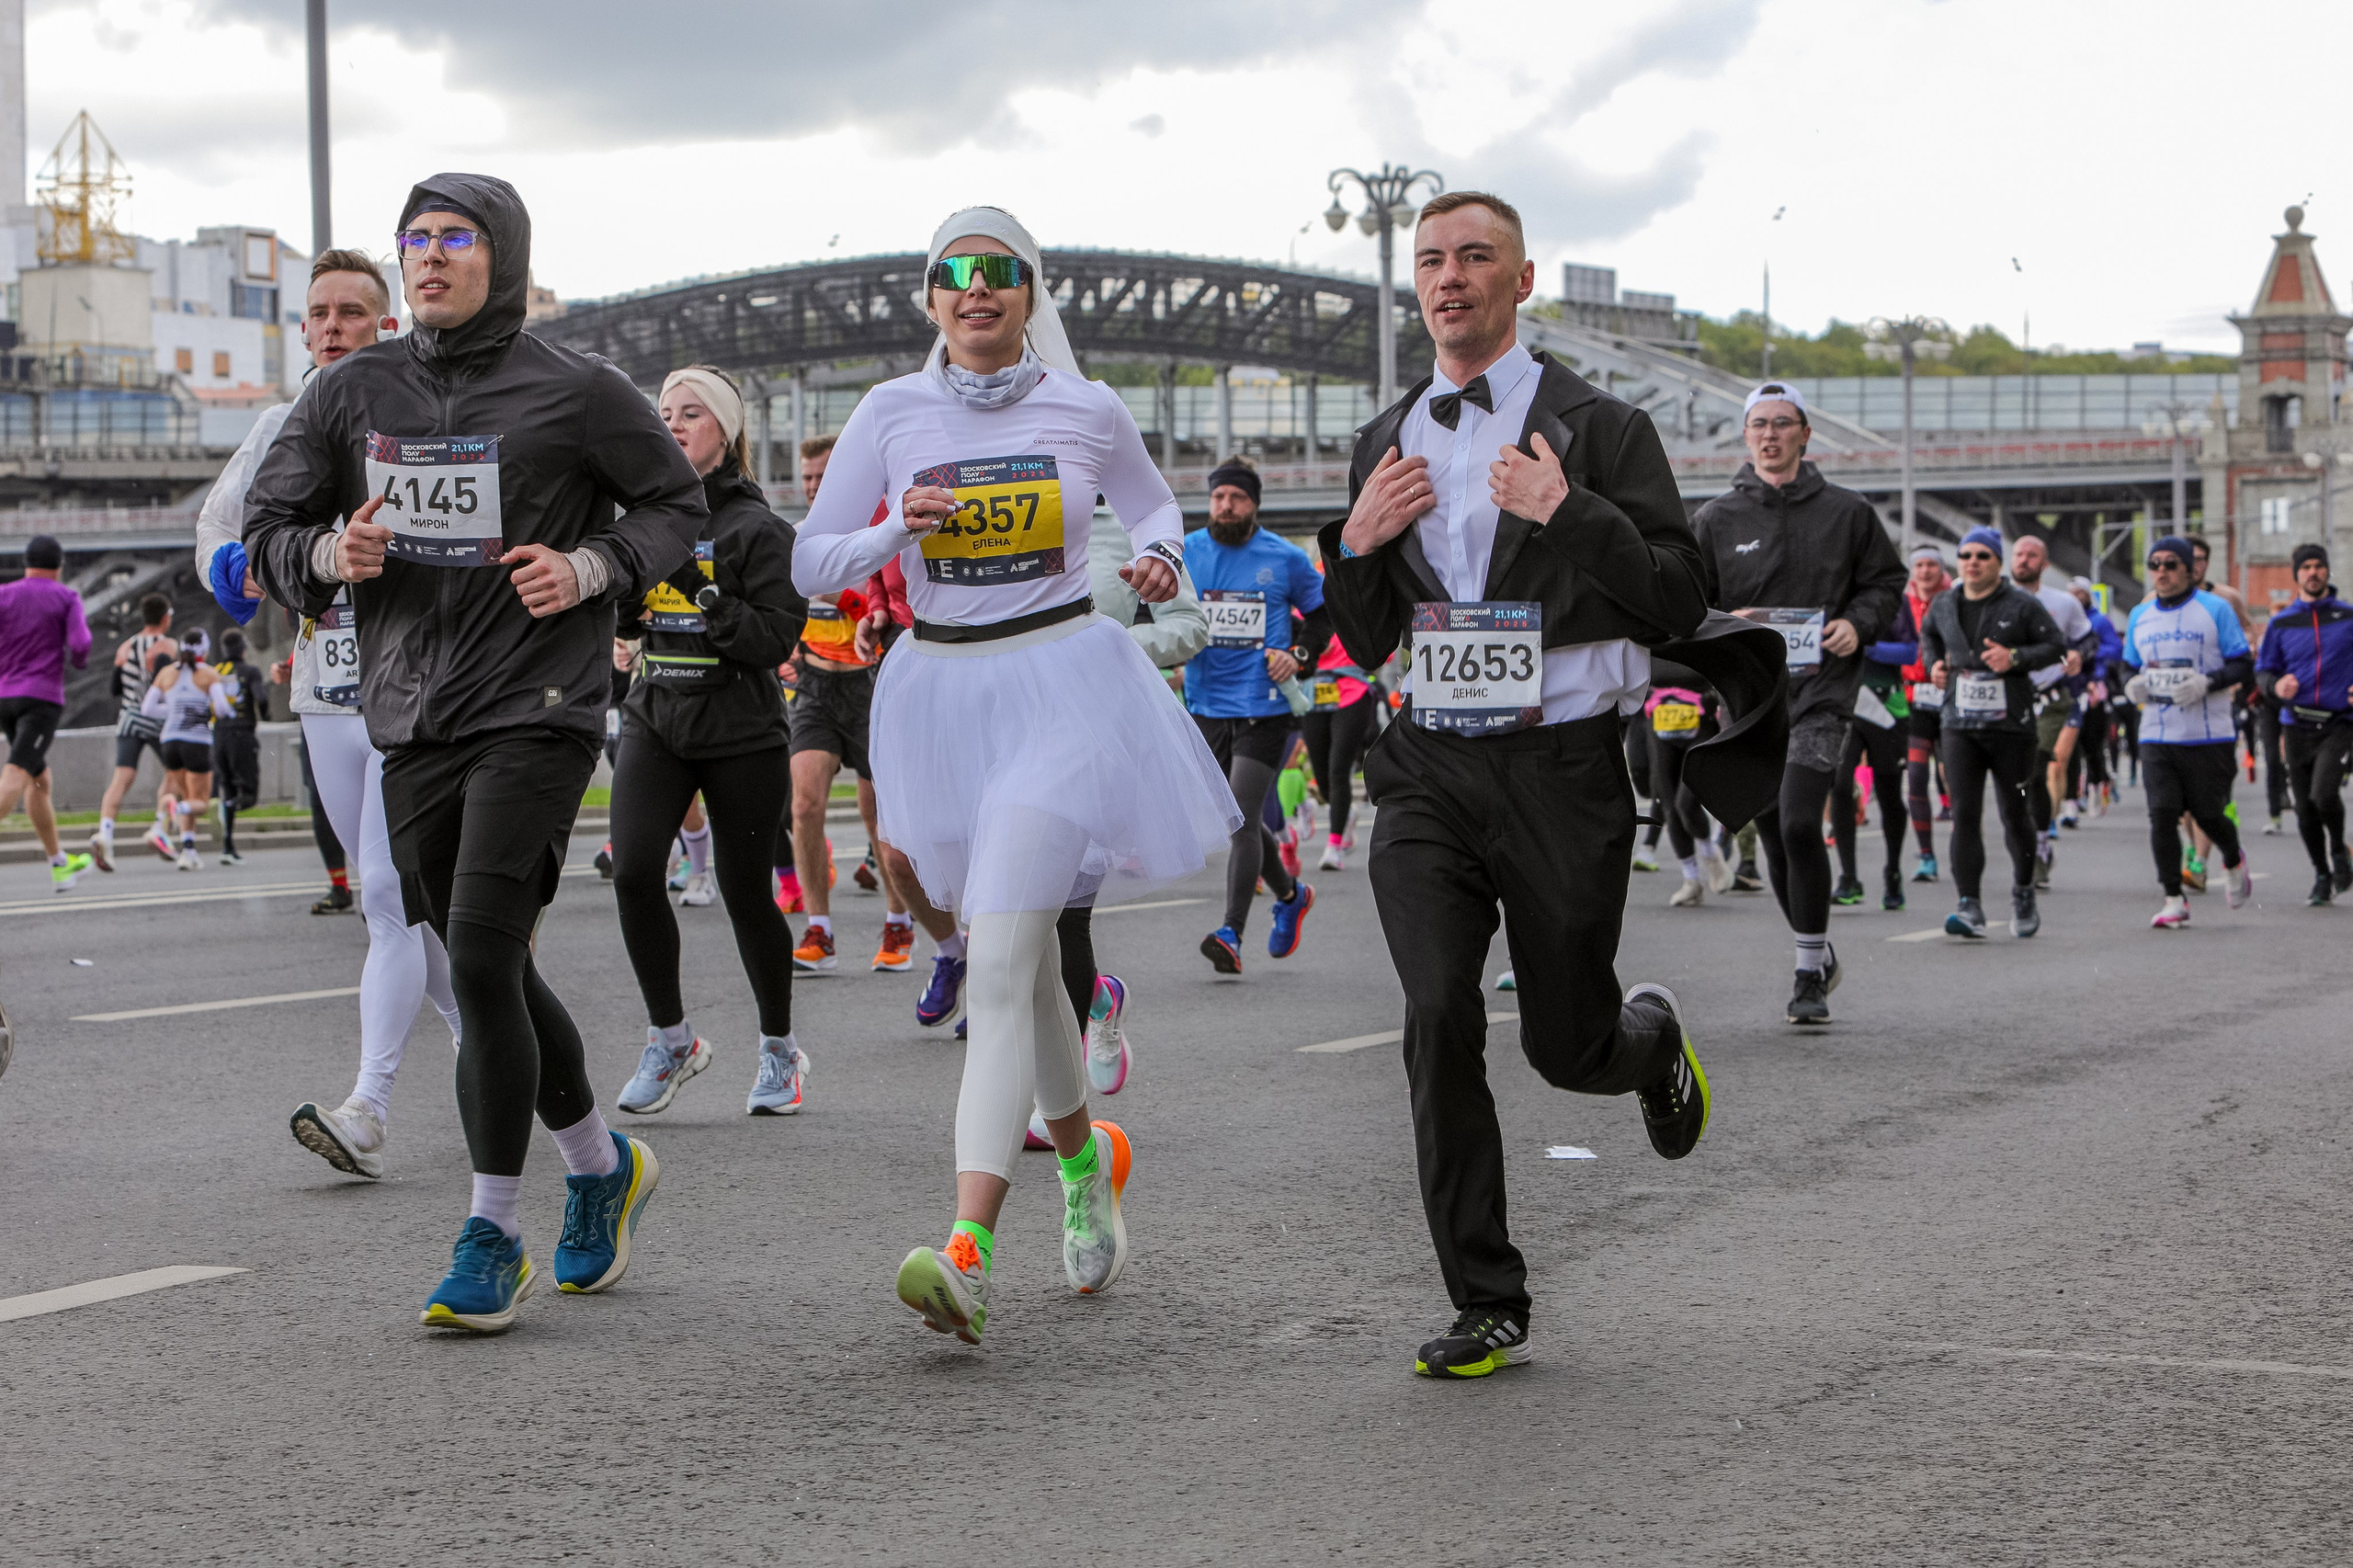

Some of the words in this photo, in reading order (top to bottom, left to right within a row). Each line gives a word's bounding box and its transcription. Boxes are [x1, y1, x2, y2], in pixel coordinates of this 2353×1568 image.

[401, 442, 448, 451] МОСКОВСКИЙ
[960, 462, 1006, 472] МОСКОВСКИЙ
[961, 475, 995, 484] МАРАФОН
[383, 475, 478, 515] 4145
[937, 493, 1040, 538] 4357
[410, 517, 449, 529] МИРОН
[972, 538, 1011, 550] ЕЛЕНА
[1206, 608, 1261, 625] 14547
[1449, 608, 1491, 616] МОСКОВСКИЙ
[1418, 644, 1534, 682] 12653
[663, 669, 706, 677] DEMIX
[1452, 687, 1488, 699] ДЕНИС
